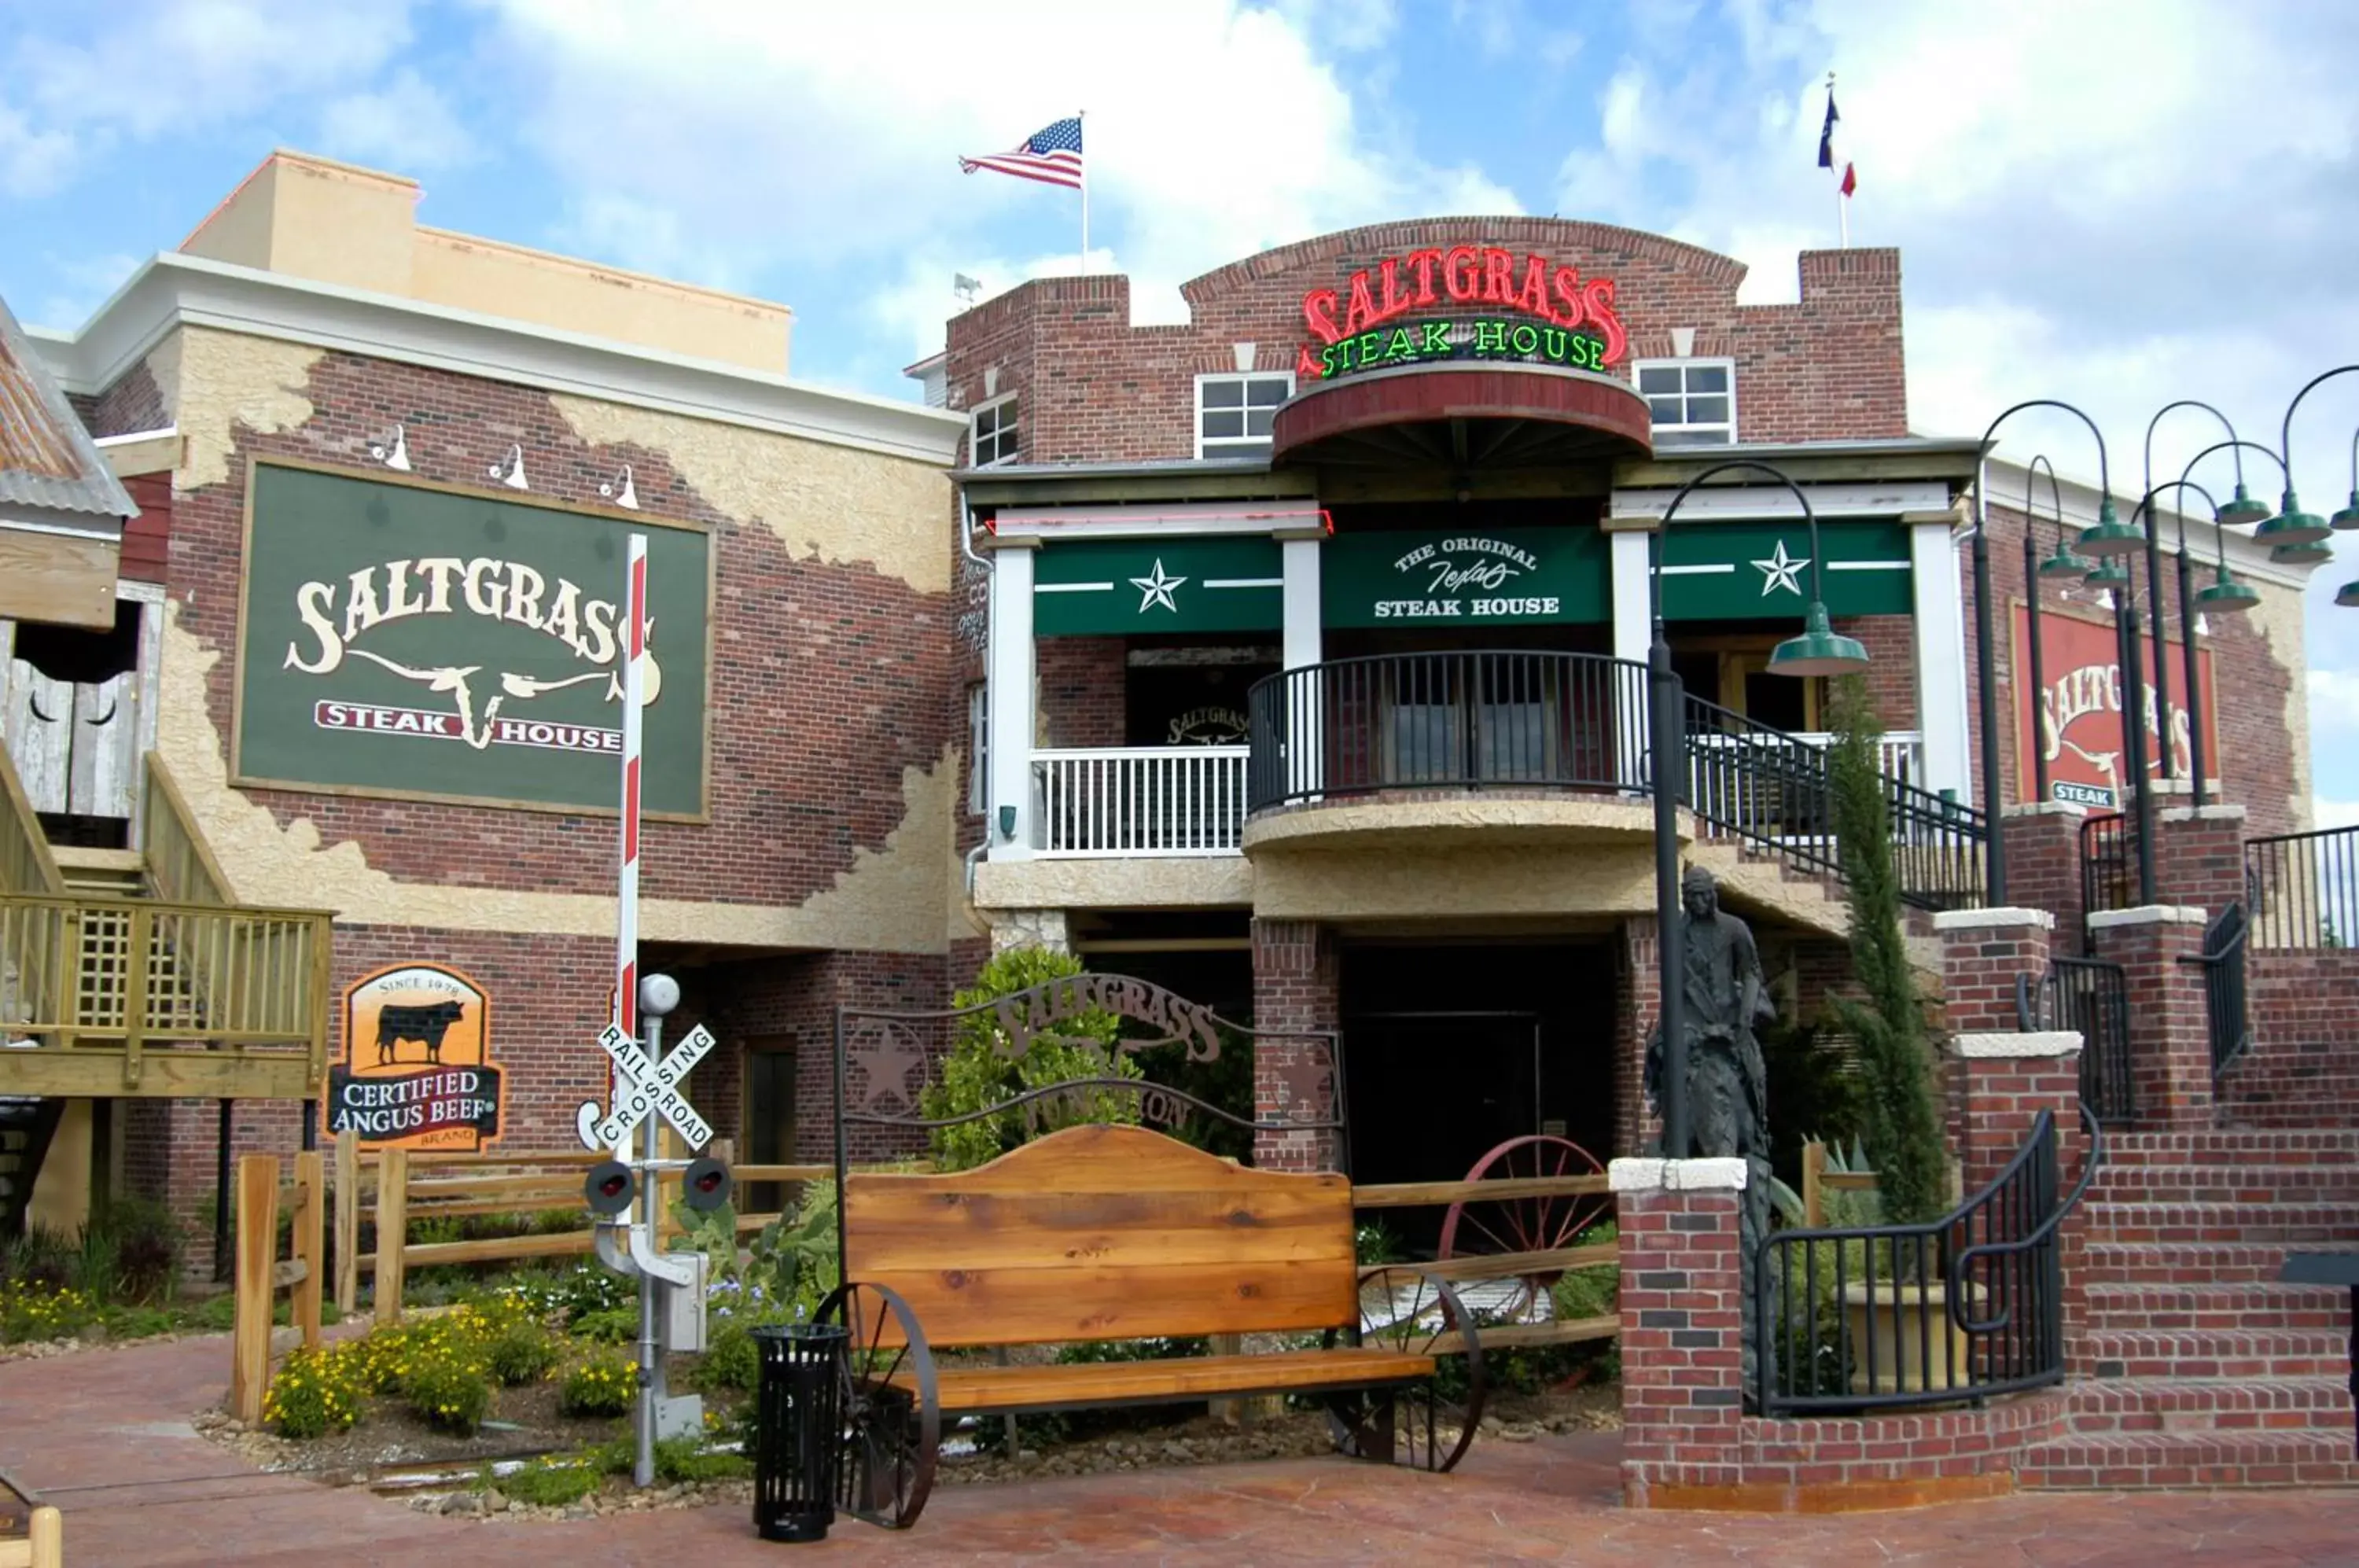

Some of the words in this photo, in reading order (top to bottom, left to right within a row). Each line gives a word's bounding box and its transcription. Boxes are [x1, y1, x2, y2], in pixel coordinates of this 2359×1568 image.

[1298, 245, 1627, 376] SALTGRASS
[1322, 322, 1453, 378] STEAK
[1474, 321, 1606, 371] HOUSE
[1393, 543, 1436, 573] THE
[1441, 537, 1537, 571] ORIGINAL
[1427, 558, 1520, 593] Texas
[1375, 599, 1462, 617] STEAK
[1470, 597, 1559, 616] HOUSE
[326, 705, 447, 735] STEAK
[500, 722, 621, 750] HOUSE
[1167, 707, 1251, 744] SALTGRAS
[2055, 785, 2109, 804] STEAK
[378, 977, 421, 996] SINCE
[344, 1071, 478, 1107] CERTIFIED
[603, 1032, 709, 1142] CROSSING
[333, 1104, 423, 1132] ANGUS
[421, 1130, 474, 1147] BRAND
